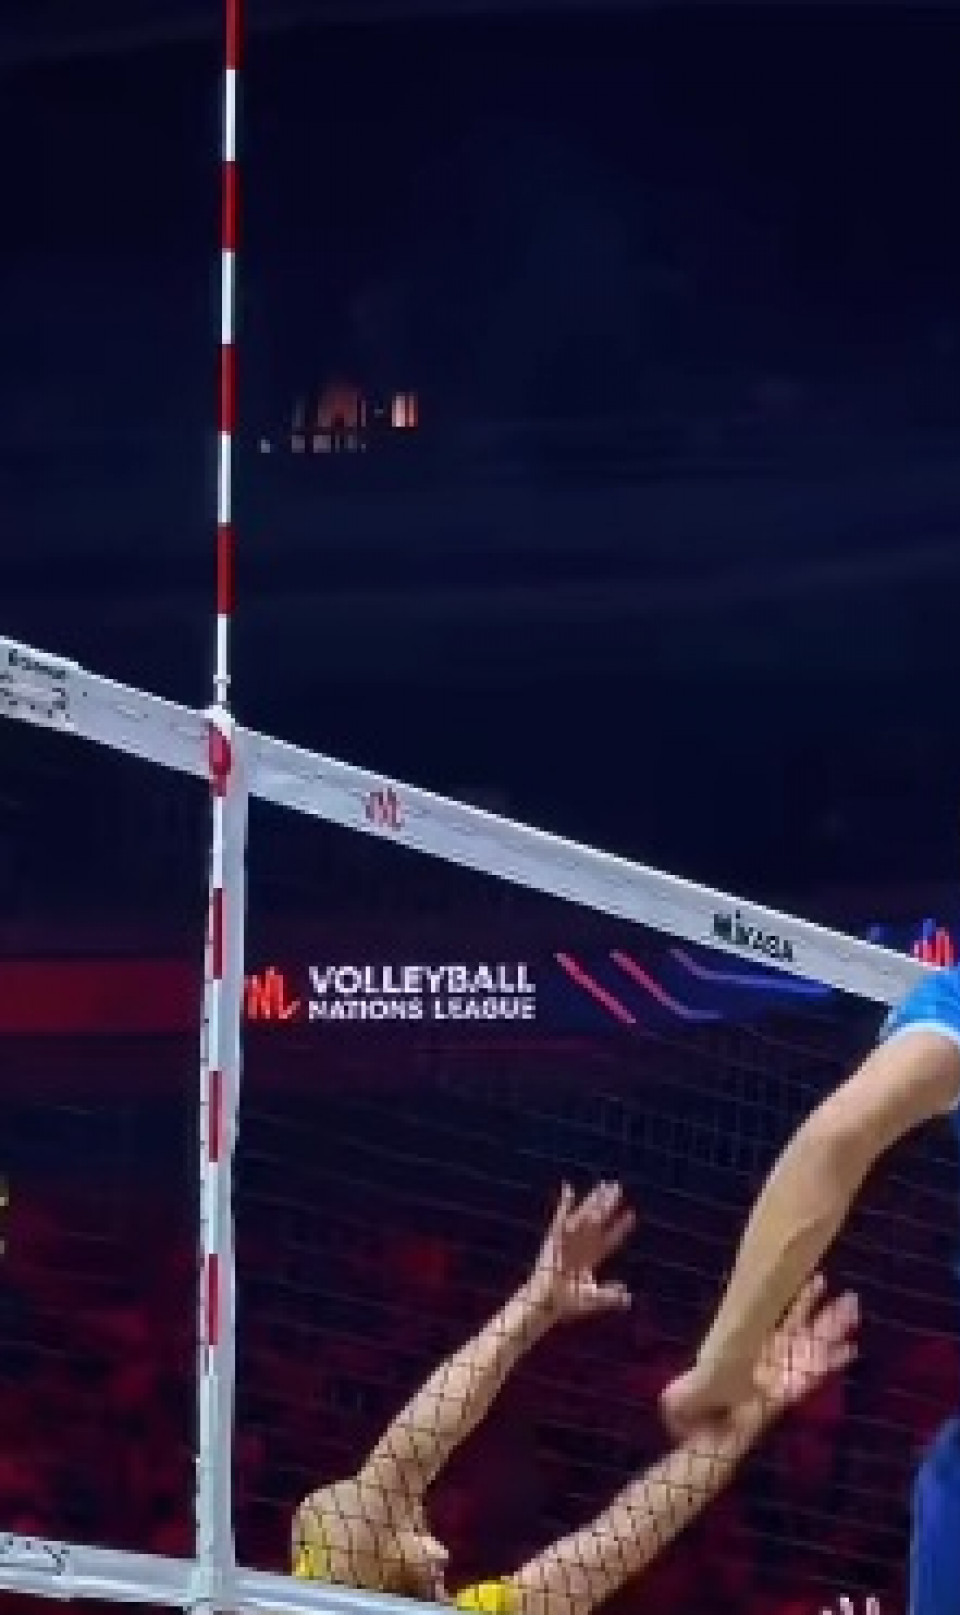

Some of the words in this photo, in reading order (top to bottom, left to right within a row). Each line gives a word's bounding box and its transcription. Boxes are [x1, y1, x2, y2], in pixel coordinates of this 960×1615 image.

[308, 964, 536, 994] VOLLEYBALL
[308, 997, 423, 1021] NATIONS
[433, 997, 536, 1021] LEAGUE
